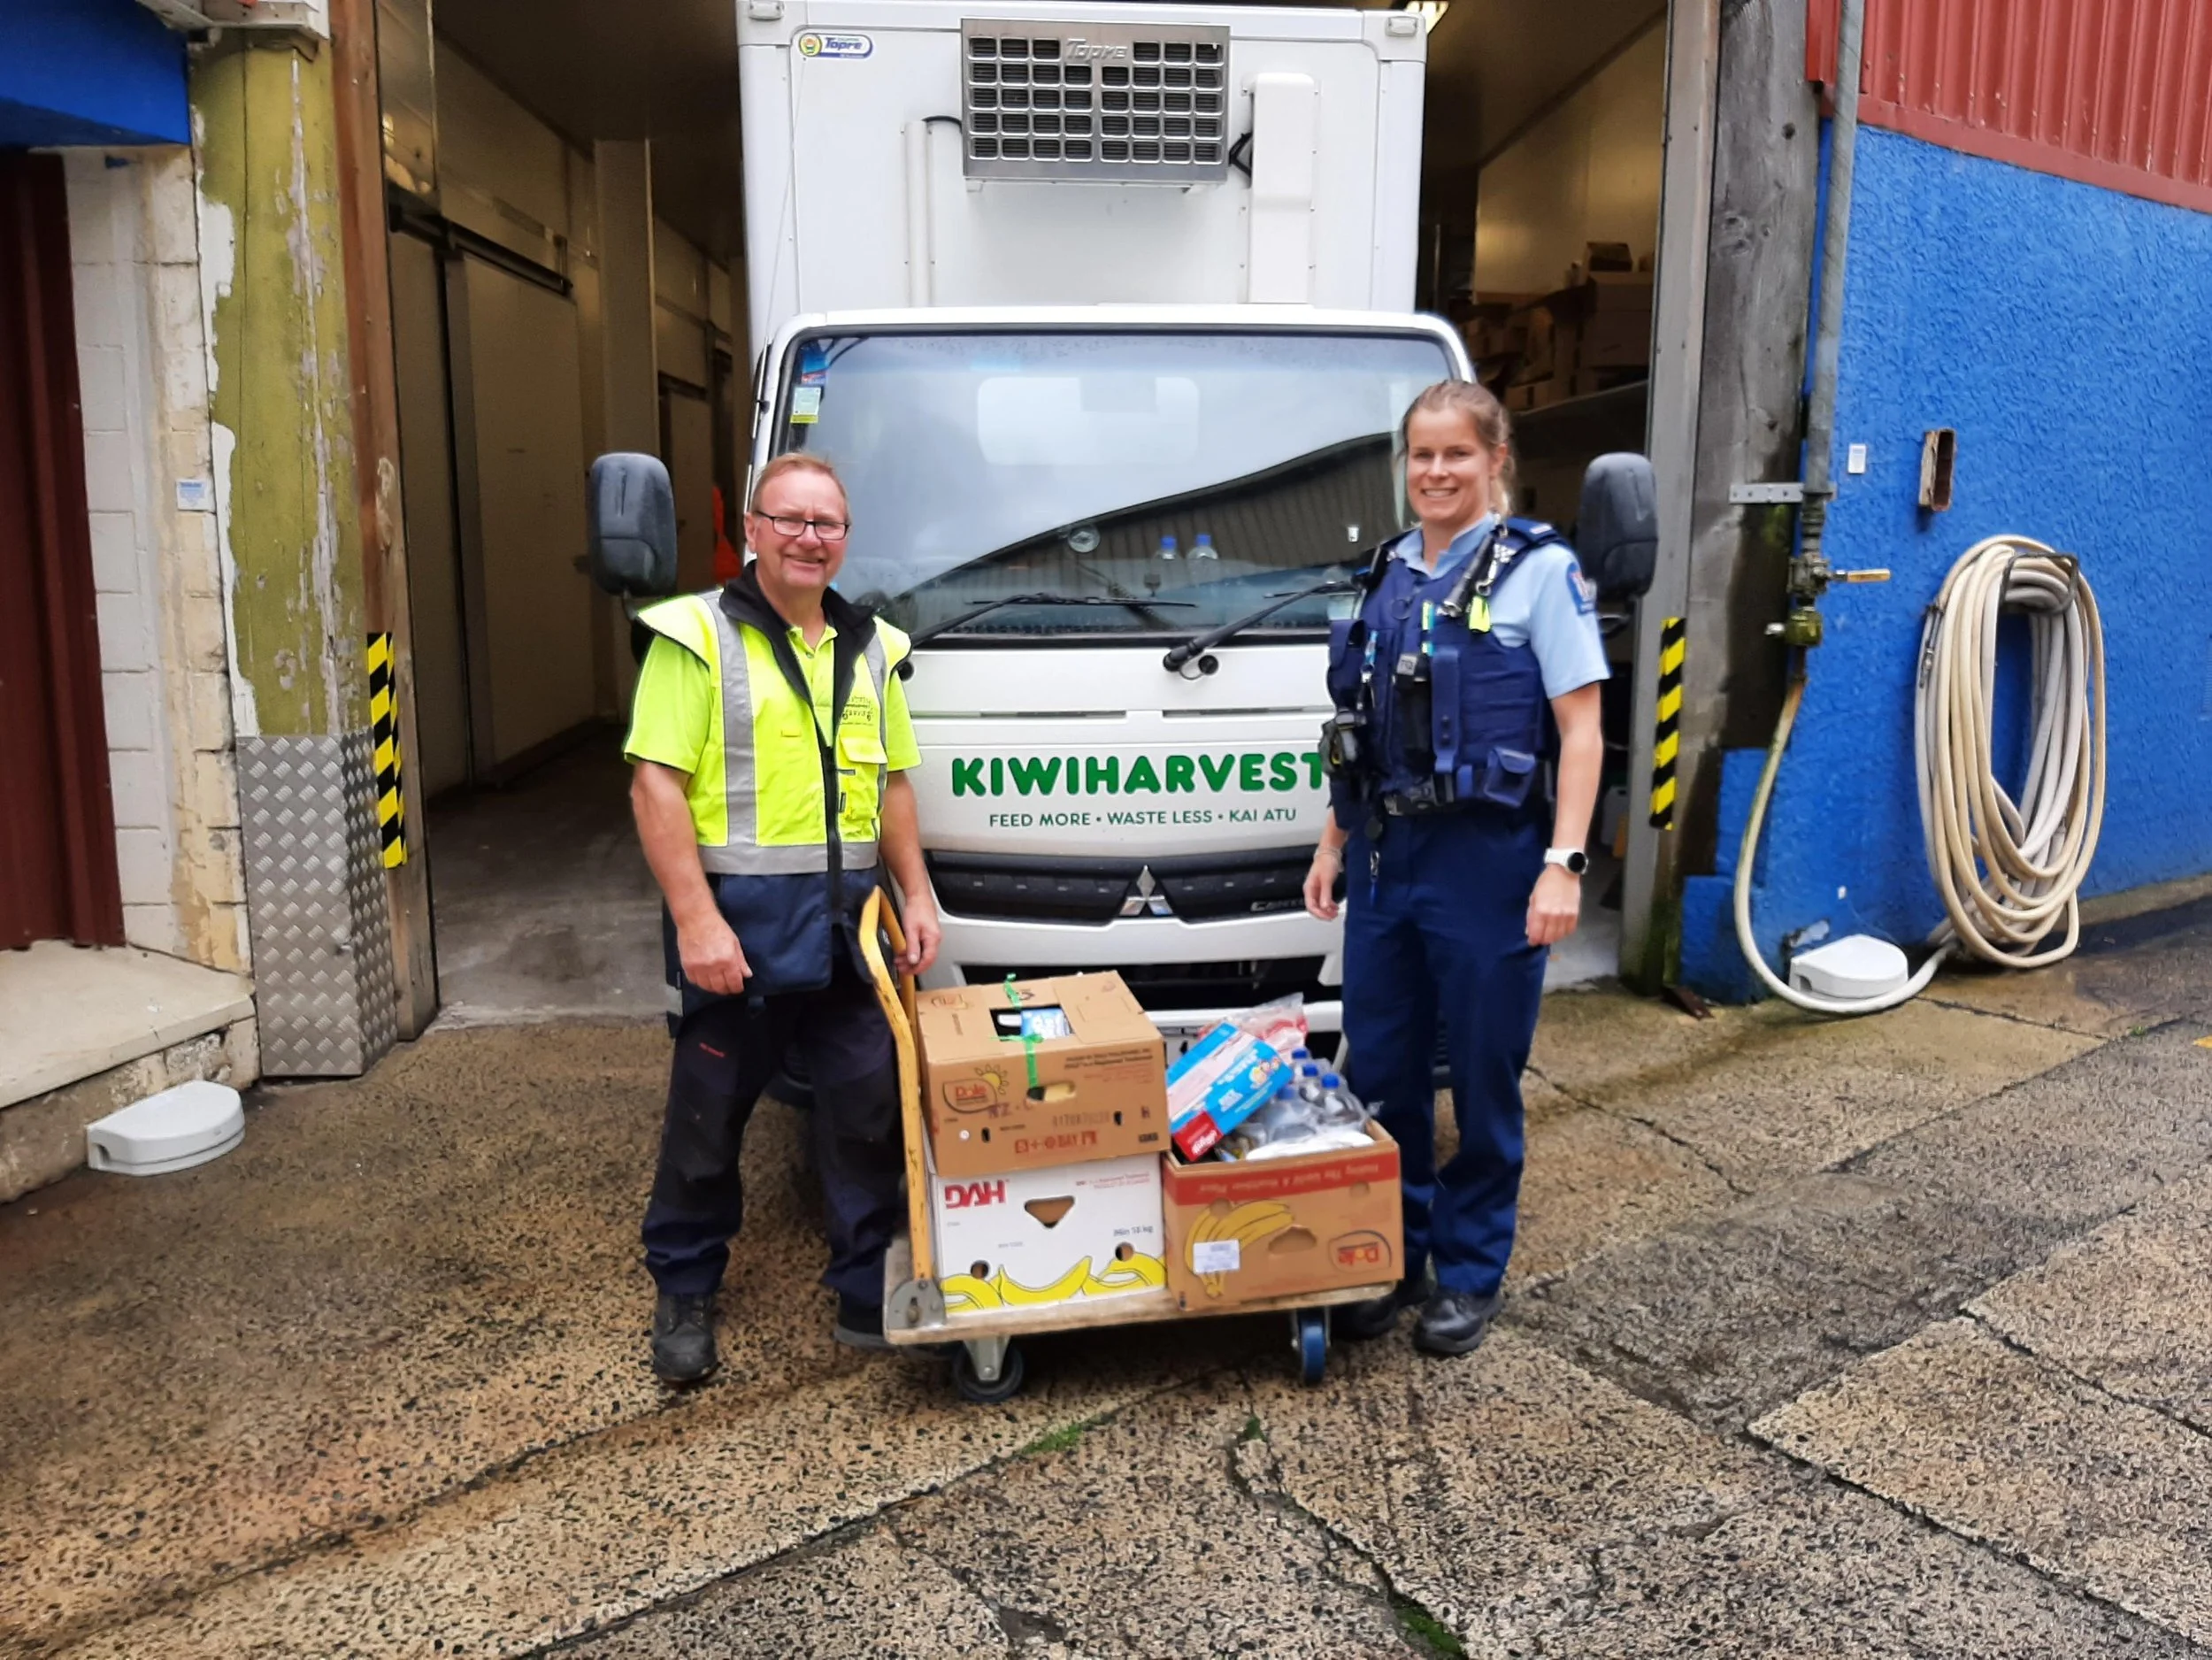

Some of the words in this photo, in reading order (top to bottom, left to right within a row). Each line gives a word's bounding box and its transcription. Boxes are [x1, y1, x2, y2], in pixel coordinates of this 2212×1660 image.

[826, 37, 863, 50] Topre
[1066, 38, 1128, 63] Topre
[952, 752, 1323, 797] KIWIHARVEST
[989, 813, 1033, 827] FEED
[1039, 812, 1091, 826] MORE
[1107, 811, 1167, 826] WASTE
[1172, 810, 1213, 824] LESS
[1229, 809, 1257, 823] KAI
[1263, 808, 1297, 822] ATU
[956, 1084, 987, 1098] Dole
[944, 1179, 1006, 1210] DAH
[1339, 1245, 1379, 1266] Dole
